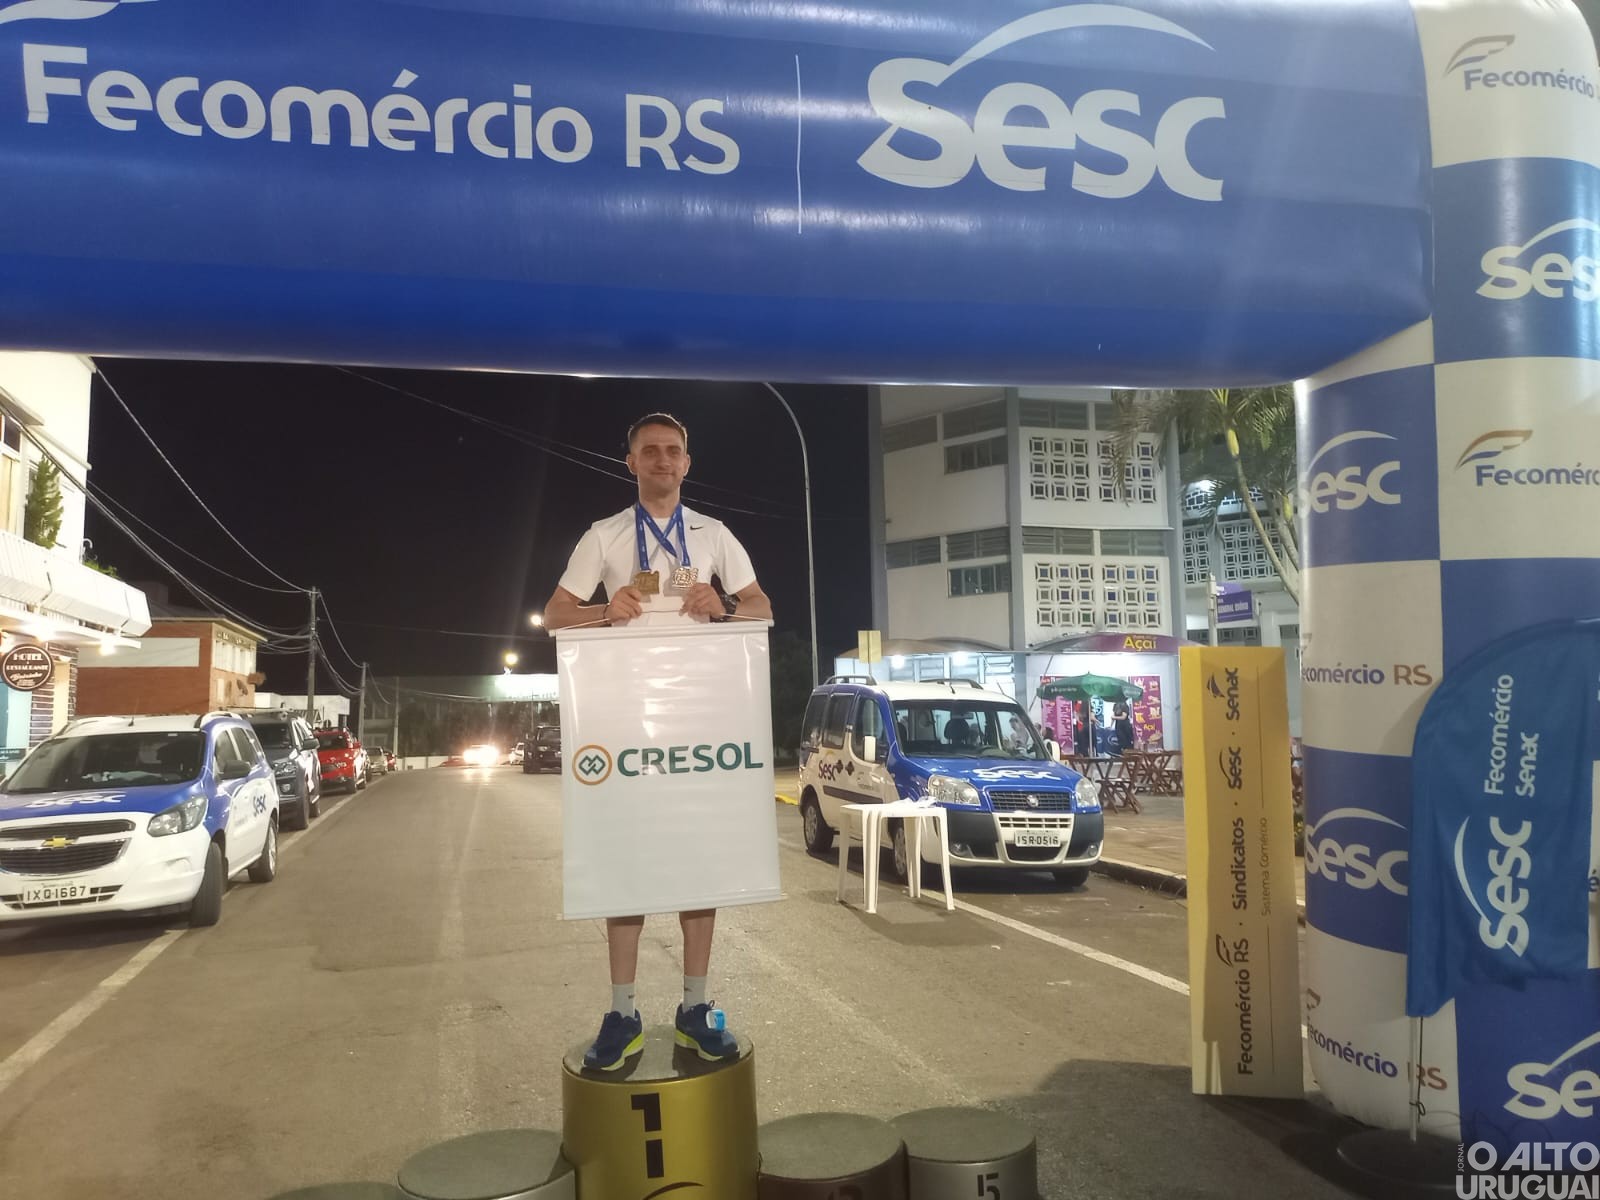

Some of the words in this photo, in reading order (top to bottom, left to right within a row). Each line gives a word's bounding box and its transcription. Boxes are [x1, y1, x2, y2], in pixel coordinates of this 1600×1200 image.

[22, 43, 593, 164] Fecomércio
[625, 94, 741, 175] RS
[1464, 68, 1595, 98] Fecomércio
[857, 57, 1227, 202] Sesc
[1225, 667, 1240, 721] Senac
[1301, 662, 1385, 685] ecomércio
[1393, 664, 1433, 686] RS
[617, 742, 764, 777] CRESOL
[1484, 674, 1514, 795] Fecomércio
[818, 759, 838, 781] Sesc
[1227, 746, 1243, 790] Sesc
[1515, 732, 1540, 798] Senac
[1231, 816, 1249, 911] Sindicatos
[1260, 816, 1271, 868] Comércio
[1261, 869, 1272, 917] Sistema
[1479, 815, 1532, 957] Sesc
[1234, 937, 1249, 963] RS
[1235, 968, 1253, 1075] Fecomércio
[1308, 1022, 1398, 1078] ecomércio
[631, 1092, 665, 1179] 1
